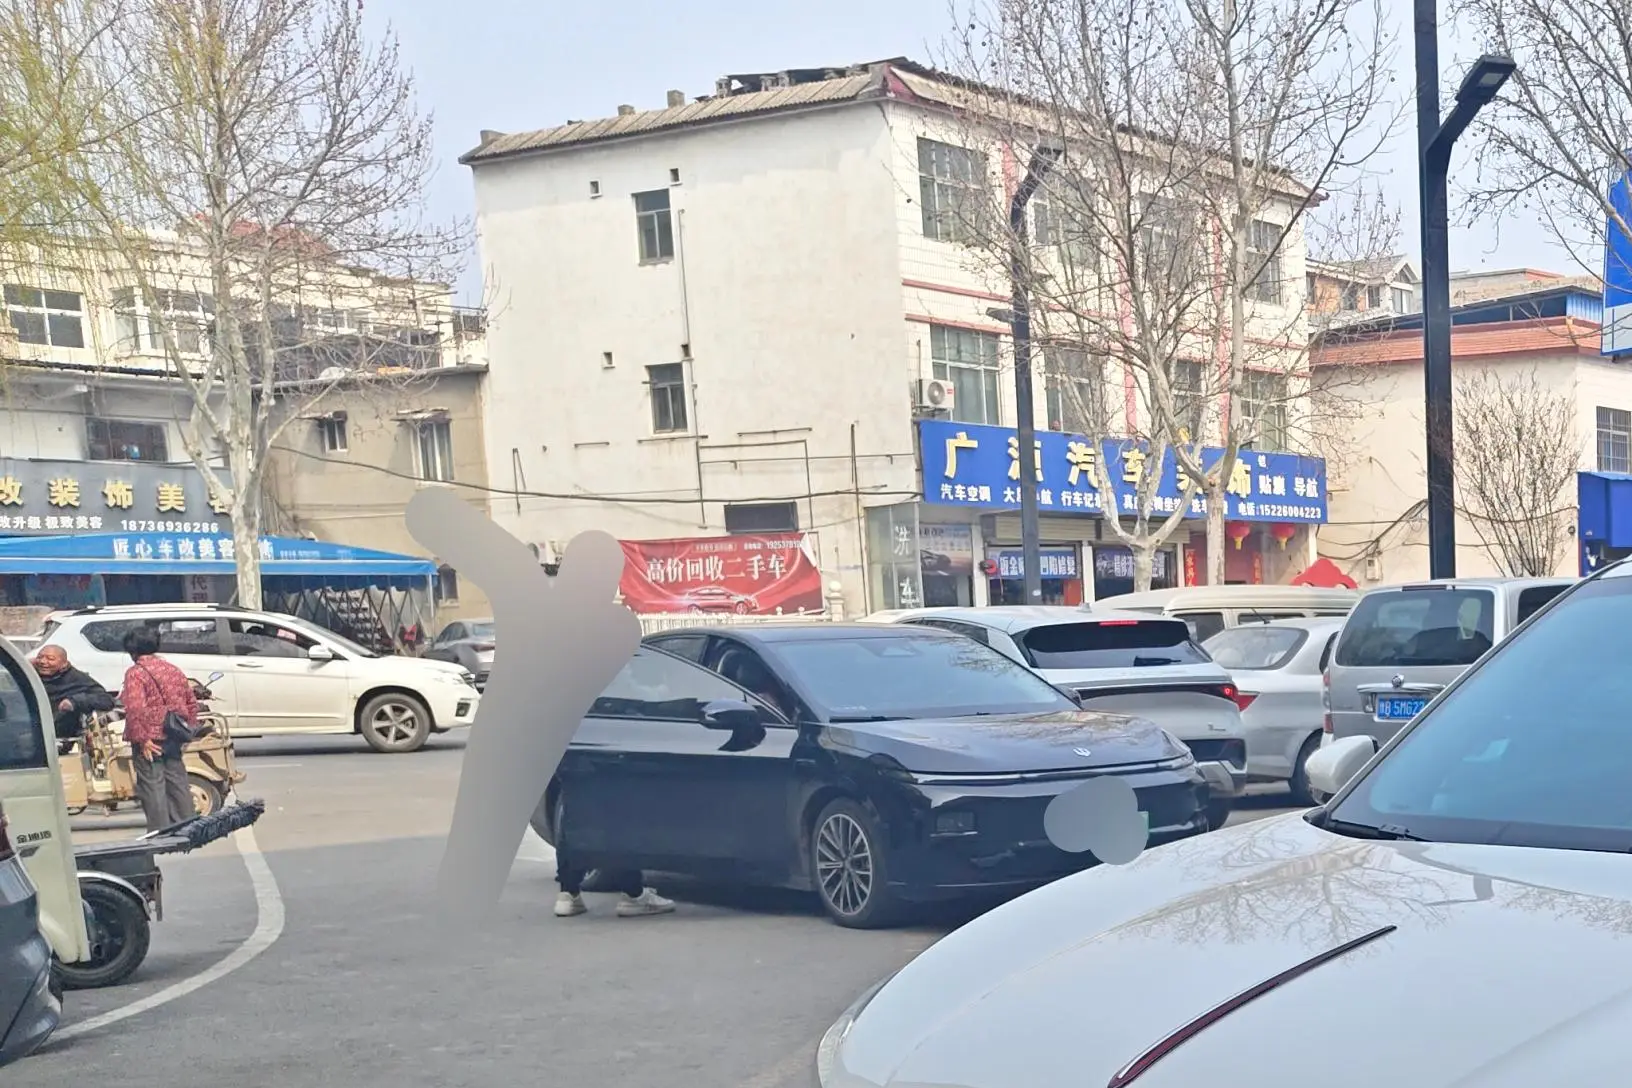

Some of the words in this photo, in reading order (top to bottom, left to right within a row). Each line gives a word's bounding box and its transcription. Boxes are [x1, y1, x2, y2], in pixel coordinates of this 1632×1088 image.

[940, 483, 991, 502] 汽车空调
[1294, 477, 1319, 498] 导航
[121, 519, 219, 533] 18736936286
[647, 553, 787, 584] 高价回收二手车
